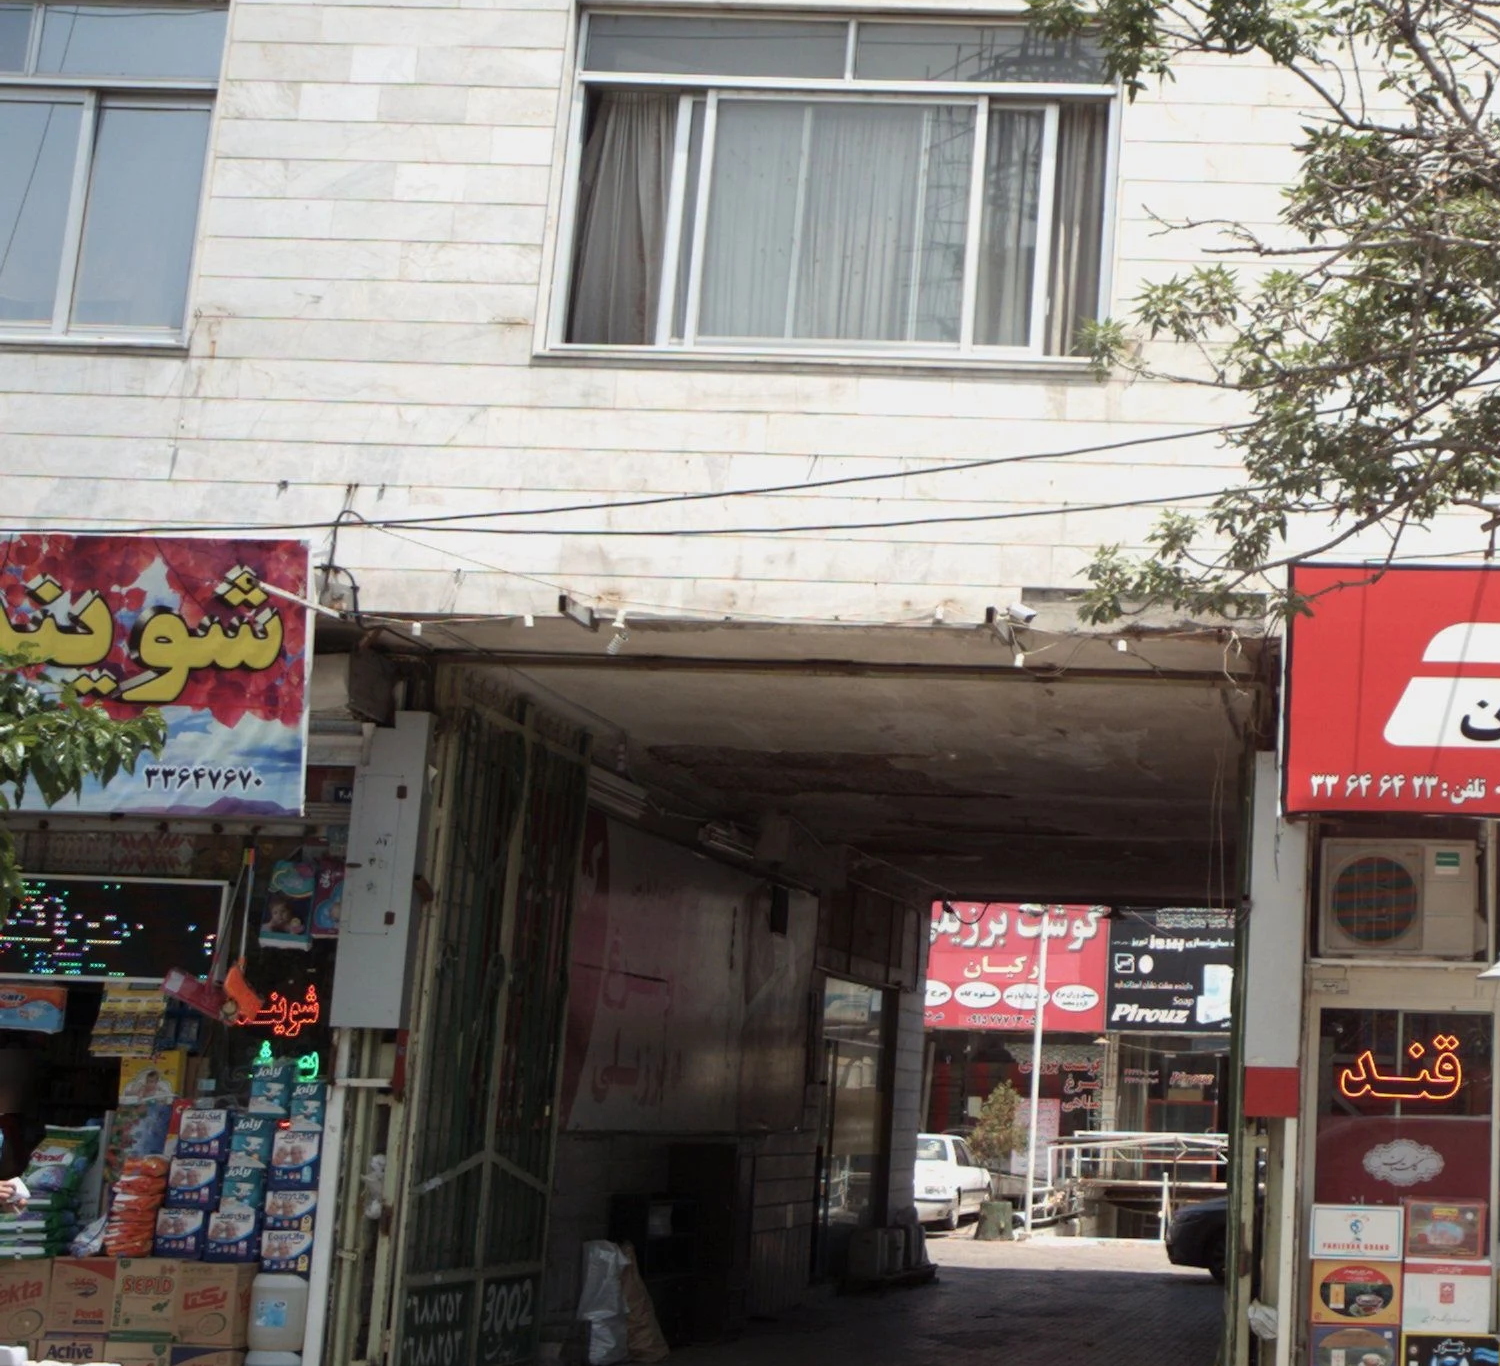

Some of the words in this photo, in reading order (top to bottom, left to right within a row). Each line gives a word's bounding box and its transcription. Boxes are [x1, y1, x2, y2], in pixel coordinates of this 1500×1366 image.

[0, 566, 283, 702] شوین
[144, 765, 264, 791] ۳۳۶۴۷۶۷۰
[1310, 774, 1339, 798] ۳۳
[1111, 1003, 1190, 1024] Pirouz
[1341, 1035, 1462, 1100] قند
[0, 1280, 44, 1305] ekta
[122, 1274, 175, 1295] SEPID
[483, 1278, 535, 1334] 3002
[46, 1341, 94, 1360] Active
